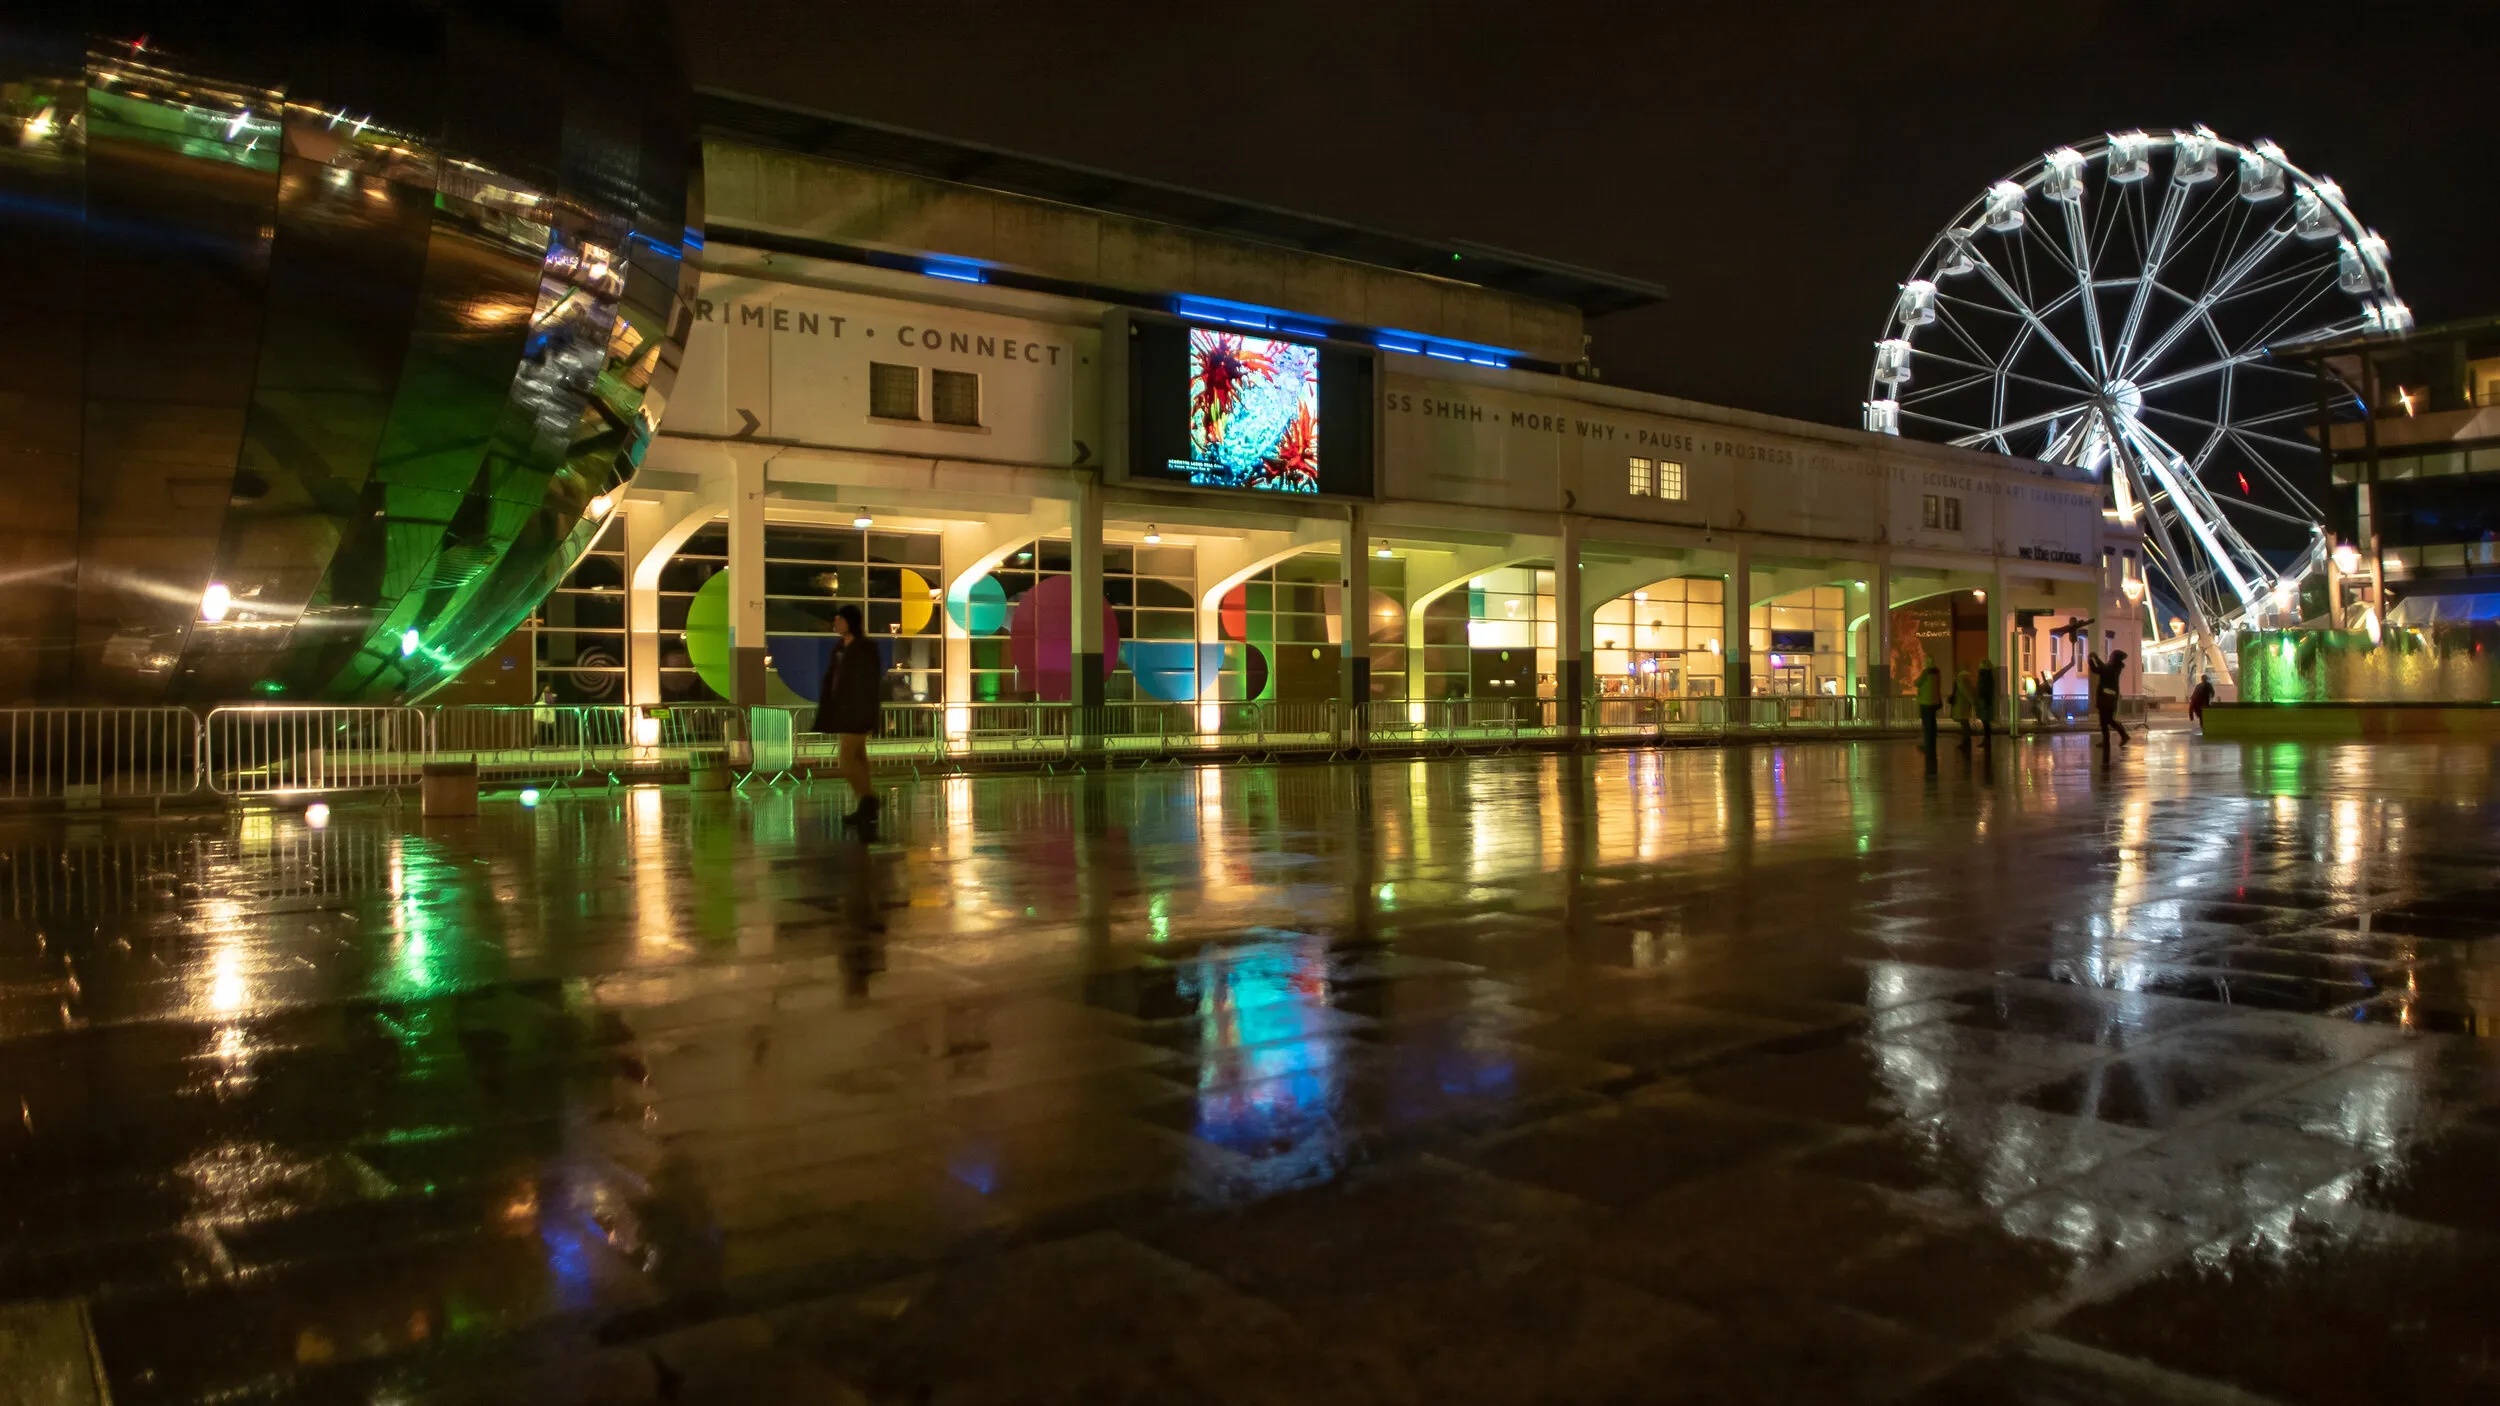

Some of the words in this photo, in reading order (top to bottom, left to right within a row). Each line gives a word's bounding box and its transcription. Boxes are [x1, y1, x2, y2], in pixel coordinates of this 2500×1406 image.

[897, 325, 1061, 366] CONNECT
[1423, 398, 1482, 422] SHHH
[1511, 411, 1565, 434] MORE
[1575, 420, 1615, 441] WHY
[1639, 429, 1693, 452] PAUSE
[1714, 442, 1793, 465] PROGRESS
[1922, 471, 1972, 491] SCIENCE
[1976, 479, 2002, 496] AND
[2006, 483, 2027, 500] ART
[2030, 487, 2092, 508] TRANSFORM
[2018, 547, 2033, 560] we
[2034, 545, 2049, 560] the
[2050, 548, 2082, 564] curious
